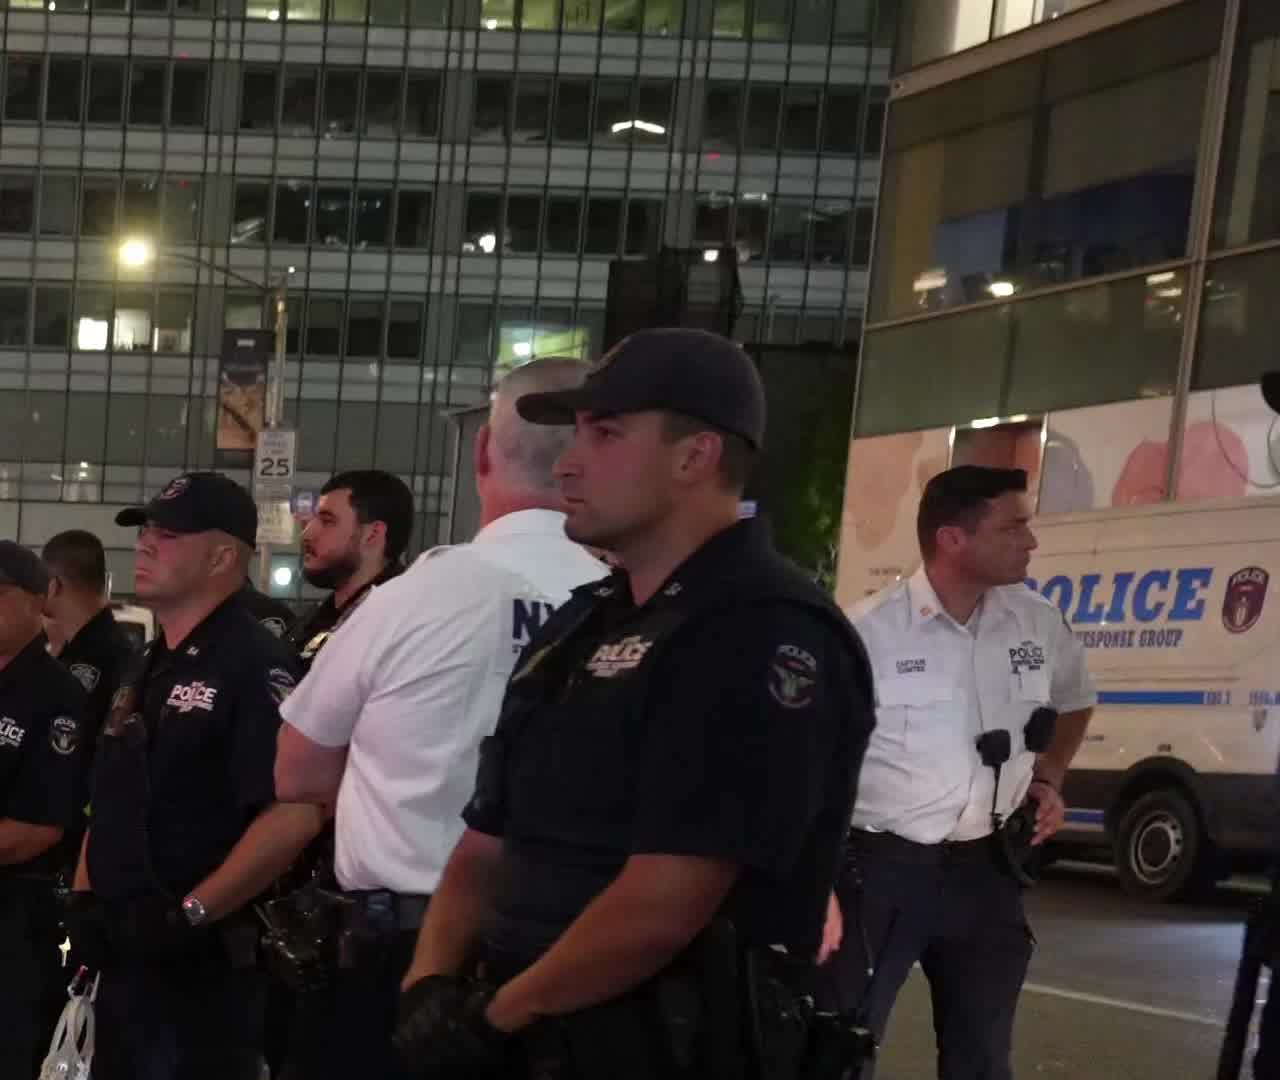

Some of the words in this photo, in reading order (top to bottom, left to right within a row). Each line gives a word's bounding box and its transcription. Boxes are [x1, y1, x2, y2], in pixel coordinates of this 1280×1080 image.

[260, 457, 289, 477] 25
[1024, 567, 1214, 624] OLICE
[1138, 628, 1184, 649] GROUP
[1008, 646, 1043, 659] POLIC
[170, 684, 217, 703] POICE
